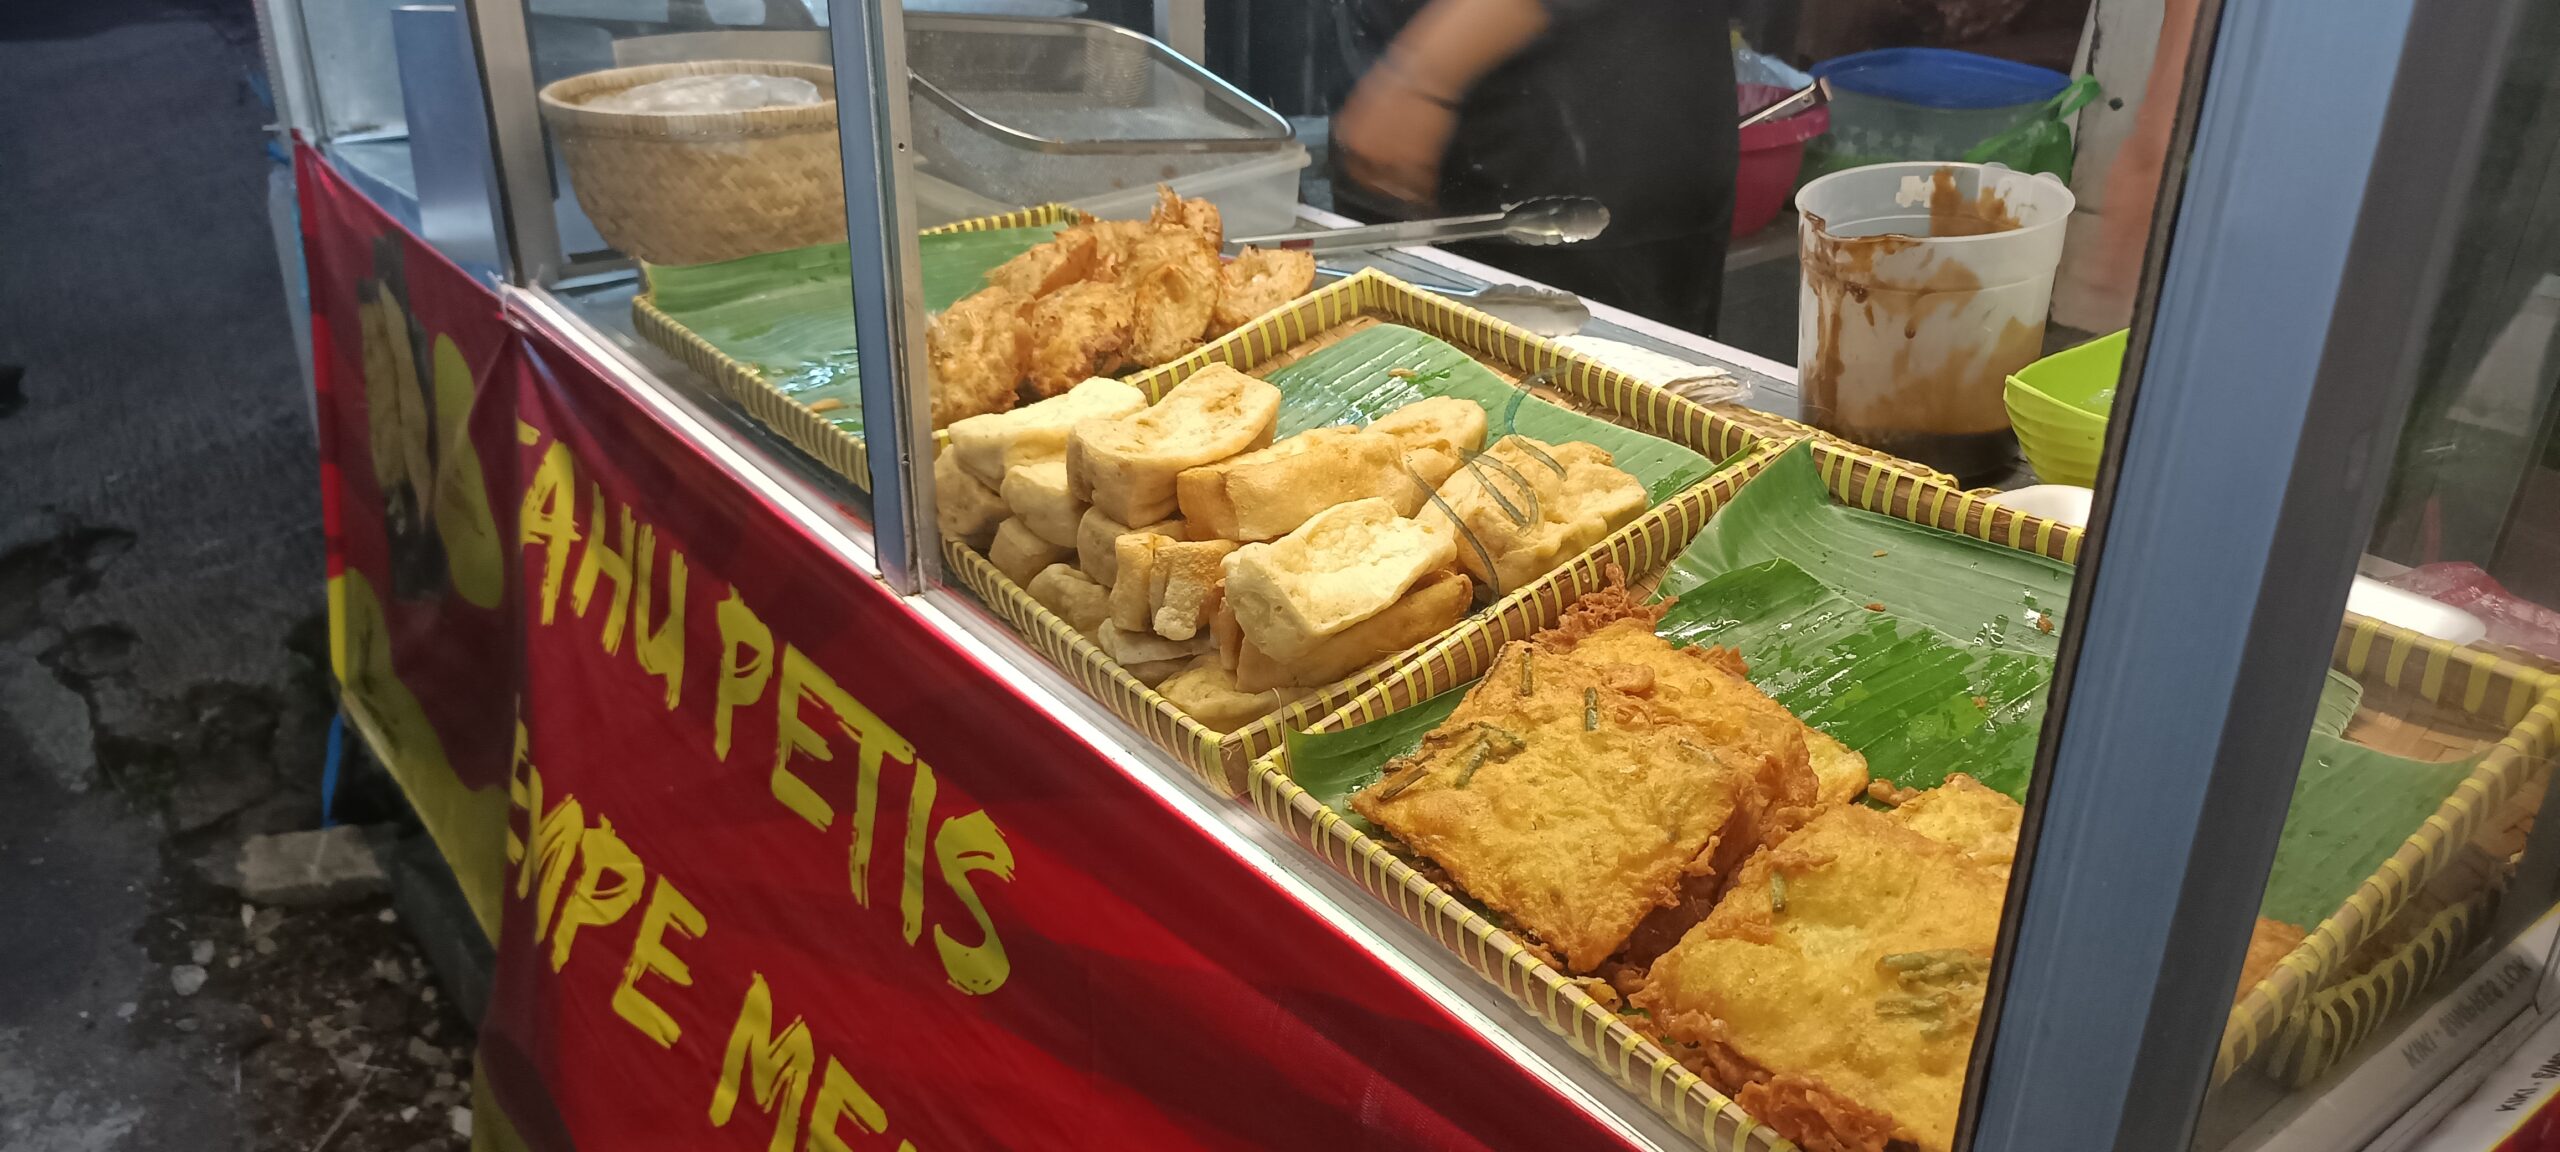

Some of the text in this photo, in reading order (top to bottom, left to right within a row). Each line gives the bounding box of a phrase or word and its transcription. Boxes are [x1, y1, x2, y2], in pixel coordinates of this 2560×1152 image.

[505, 692, 918, 1152] EMPE ME
[516, 419, 1016, 996] AHU PETIS
[2495, 1087, 2539, 1112] KIKI
